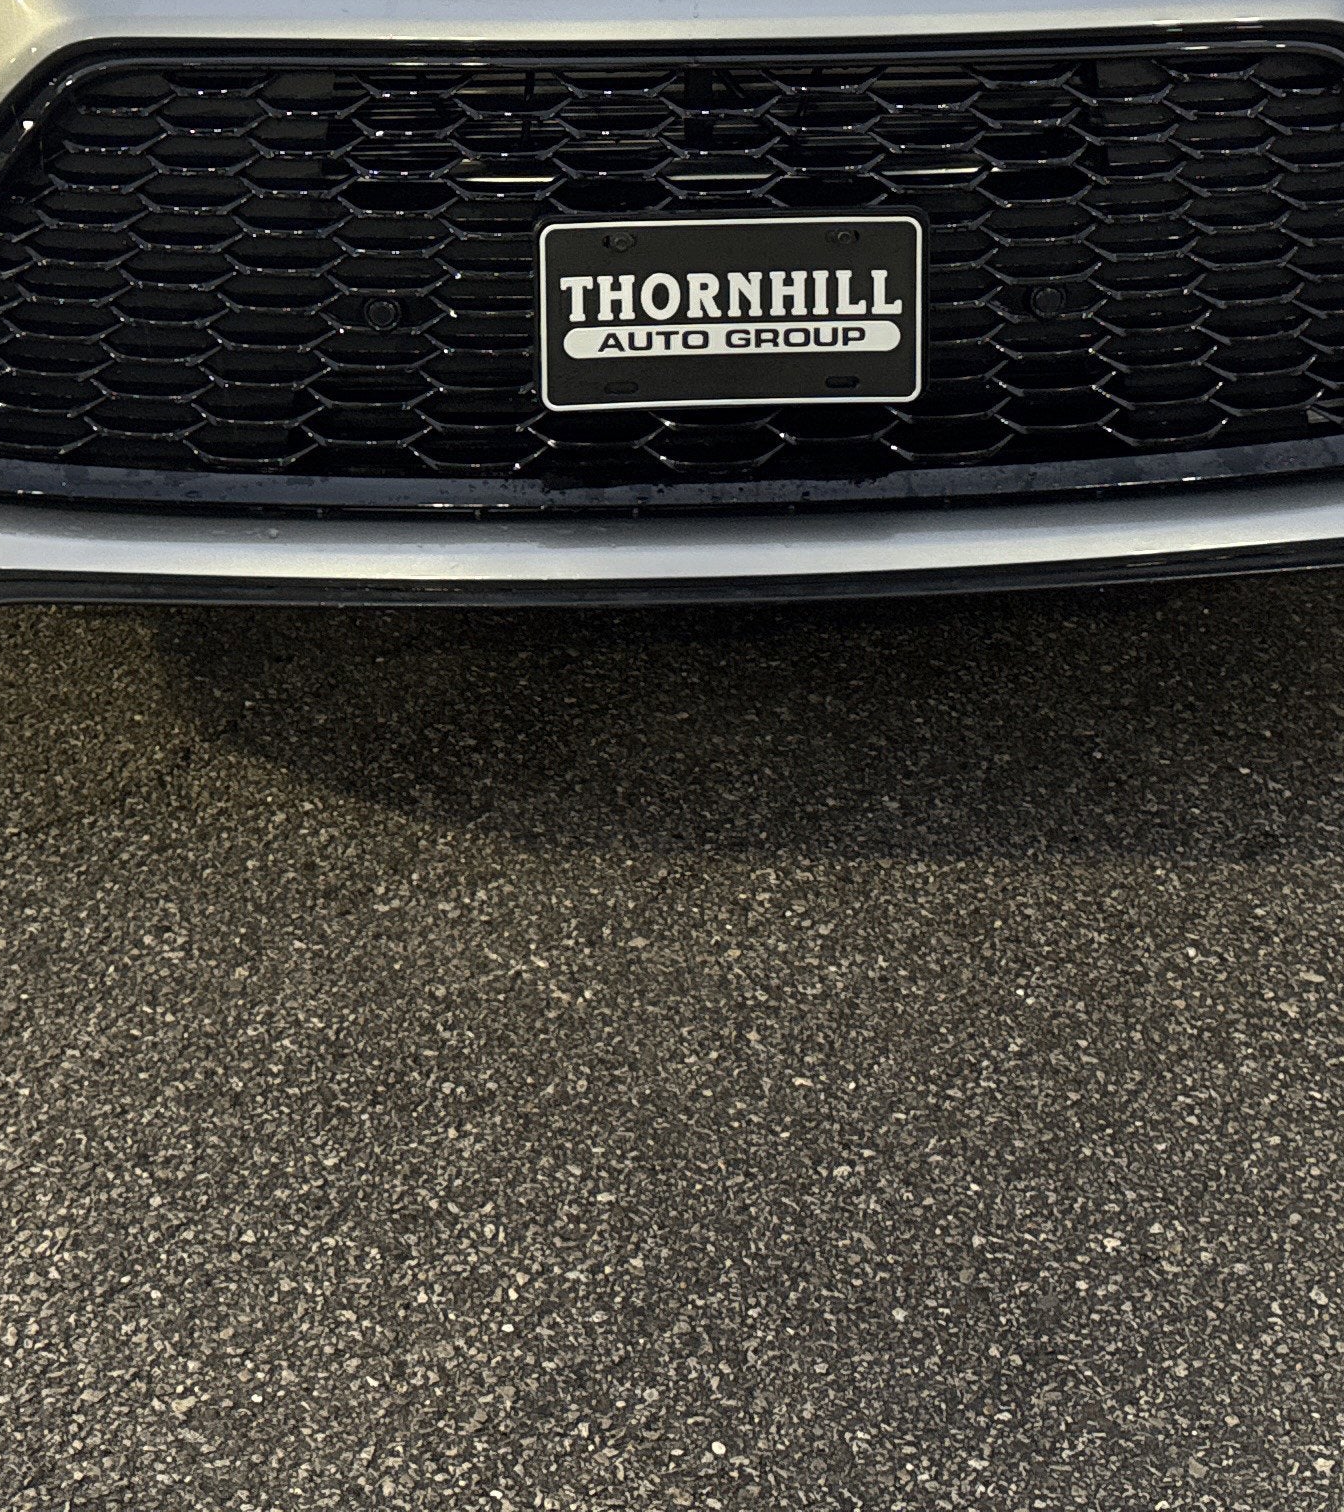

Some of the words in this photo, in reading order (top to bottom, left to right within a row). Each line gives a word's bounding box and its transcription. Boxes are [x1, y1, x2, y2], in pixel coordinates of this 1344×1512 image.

[559, 269, 903, 323] THORNHILL
[597, 329, 710, 353] AUTO
[724, 326, 867, 350] GROUP
